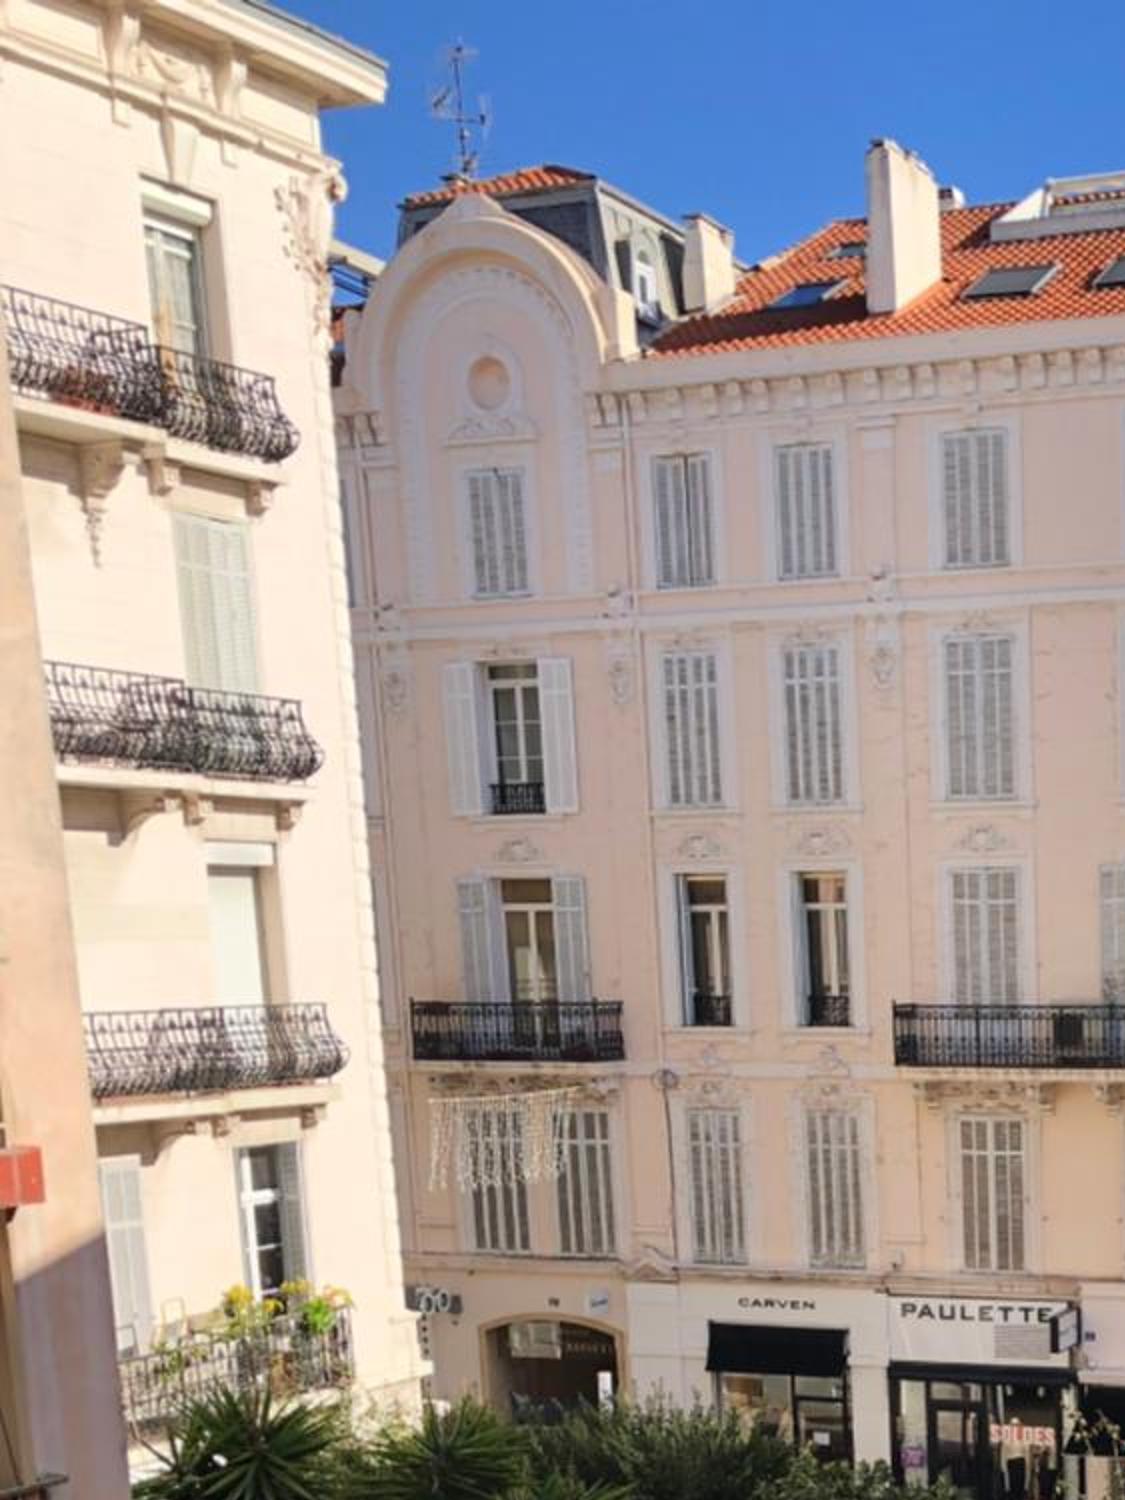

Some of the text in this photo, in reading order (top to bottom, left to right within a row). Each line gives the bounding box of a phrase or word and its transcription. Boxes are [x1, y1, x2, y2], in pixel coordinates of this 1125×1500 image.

[738, 1297, 816, 1310] CARVEN
[901, 1303, 1053, 1323] PAULETTE
[990, 1423, 1057, 1446] SOLDES
